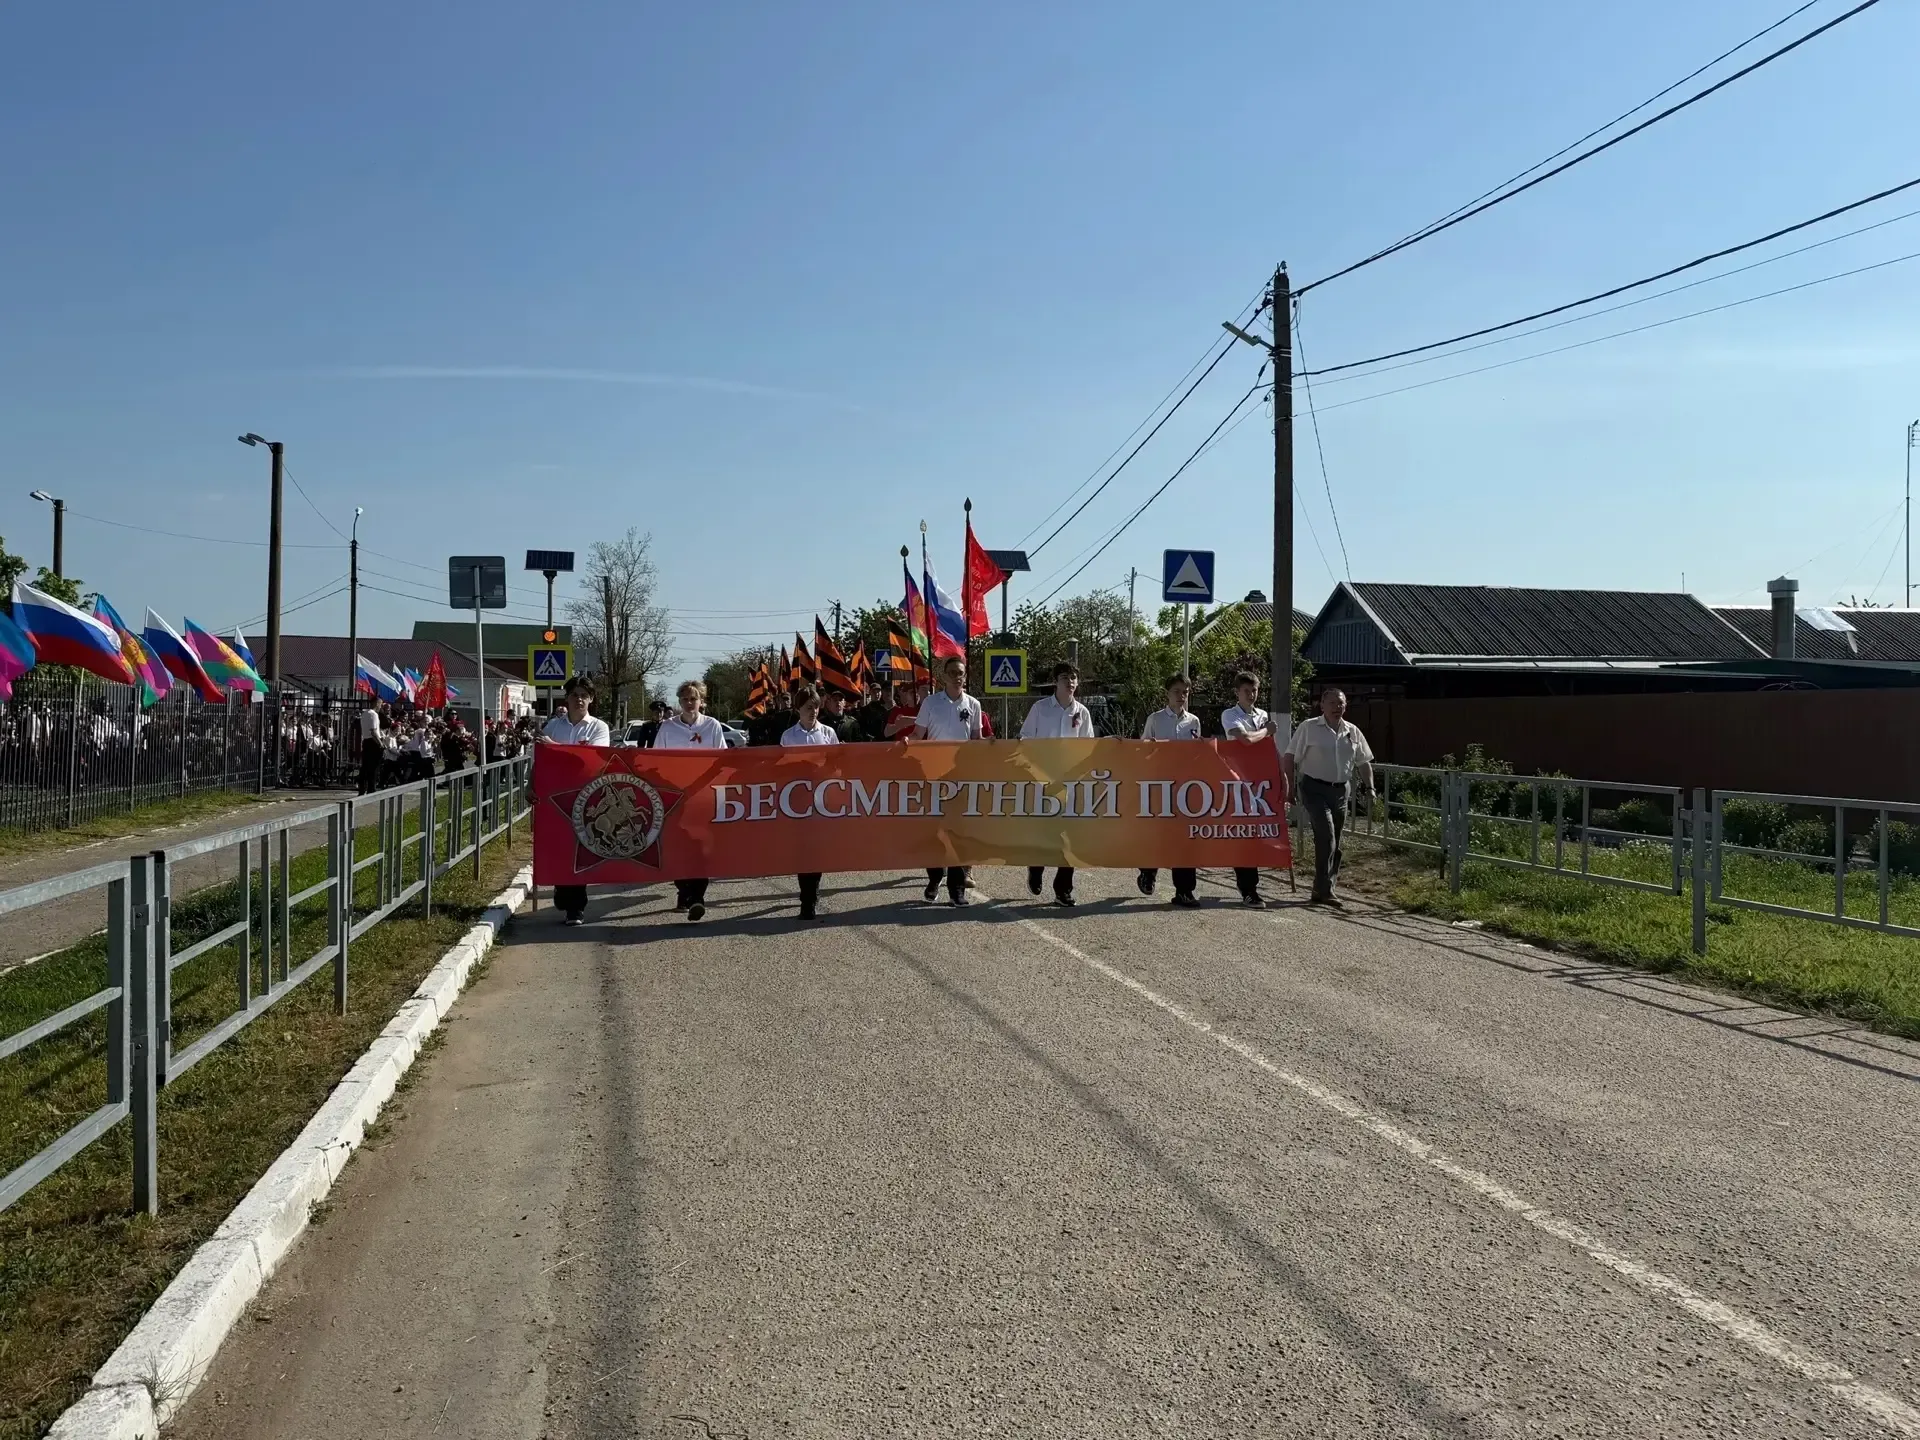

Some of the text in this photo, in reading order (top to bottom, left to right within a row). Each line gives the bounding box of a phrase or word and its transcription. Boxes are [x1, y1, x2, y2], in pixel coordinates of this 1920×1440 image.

[621, 774, 647, 789] ПОЛК
[647, 788, 664, 830] РОССИИ
[711, 769, 1276, 823] БЕССМЕРТНЫЙ ПОЛК
[1189, 824, 1279, 839] POLKRF.RU
